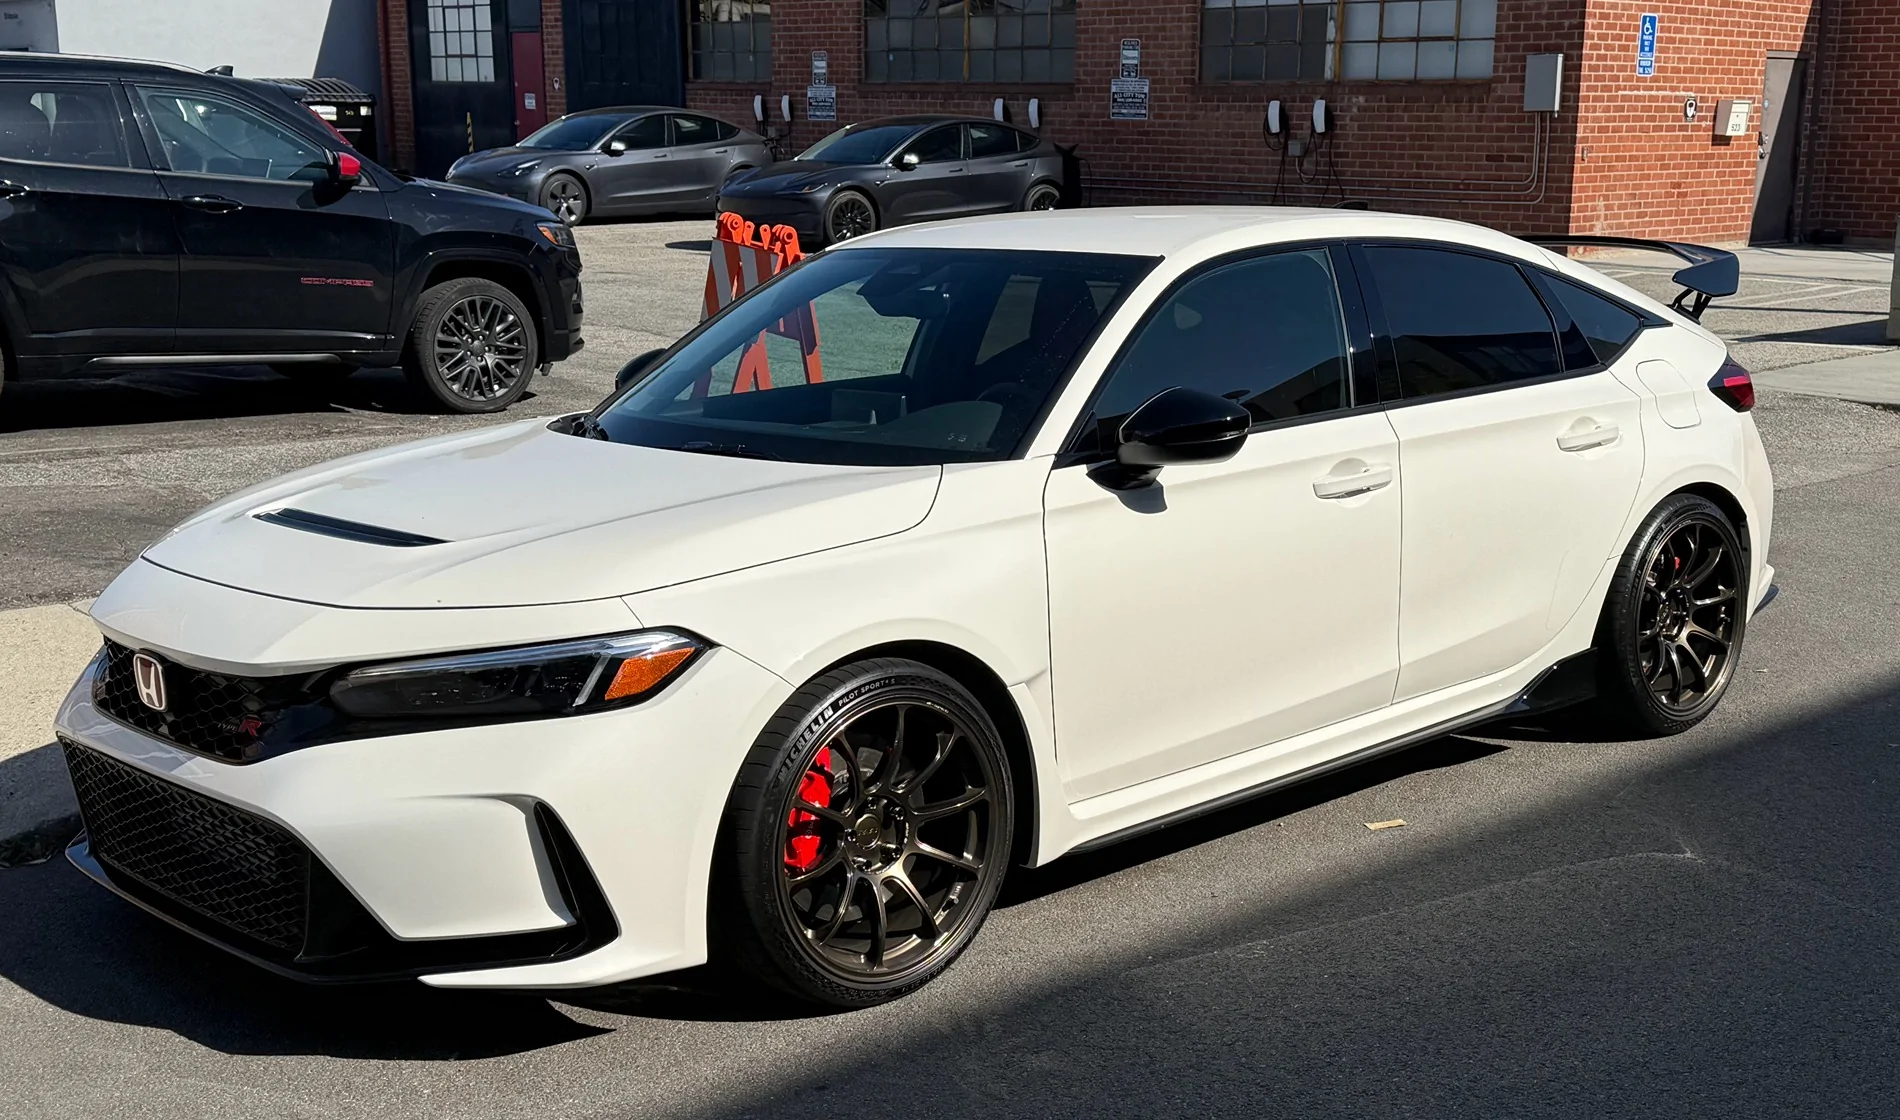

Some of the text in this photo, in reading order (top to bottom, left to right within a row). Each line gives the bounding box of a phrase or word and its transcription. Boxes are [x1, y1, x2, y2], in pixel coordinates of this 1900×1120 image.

[300, 277, 374, 287] COMPASS
[777, 705, 834, 782] MICHELIN
[838, 690, 858, 707] PILOT
[860, 680, 884, 693] SPORT
